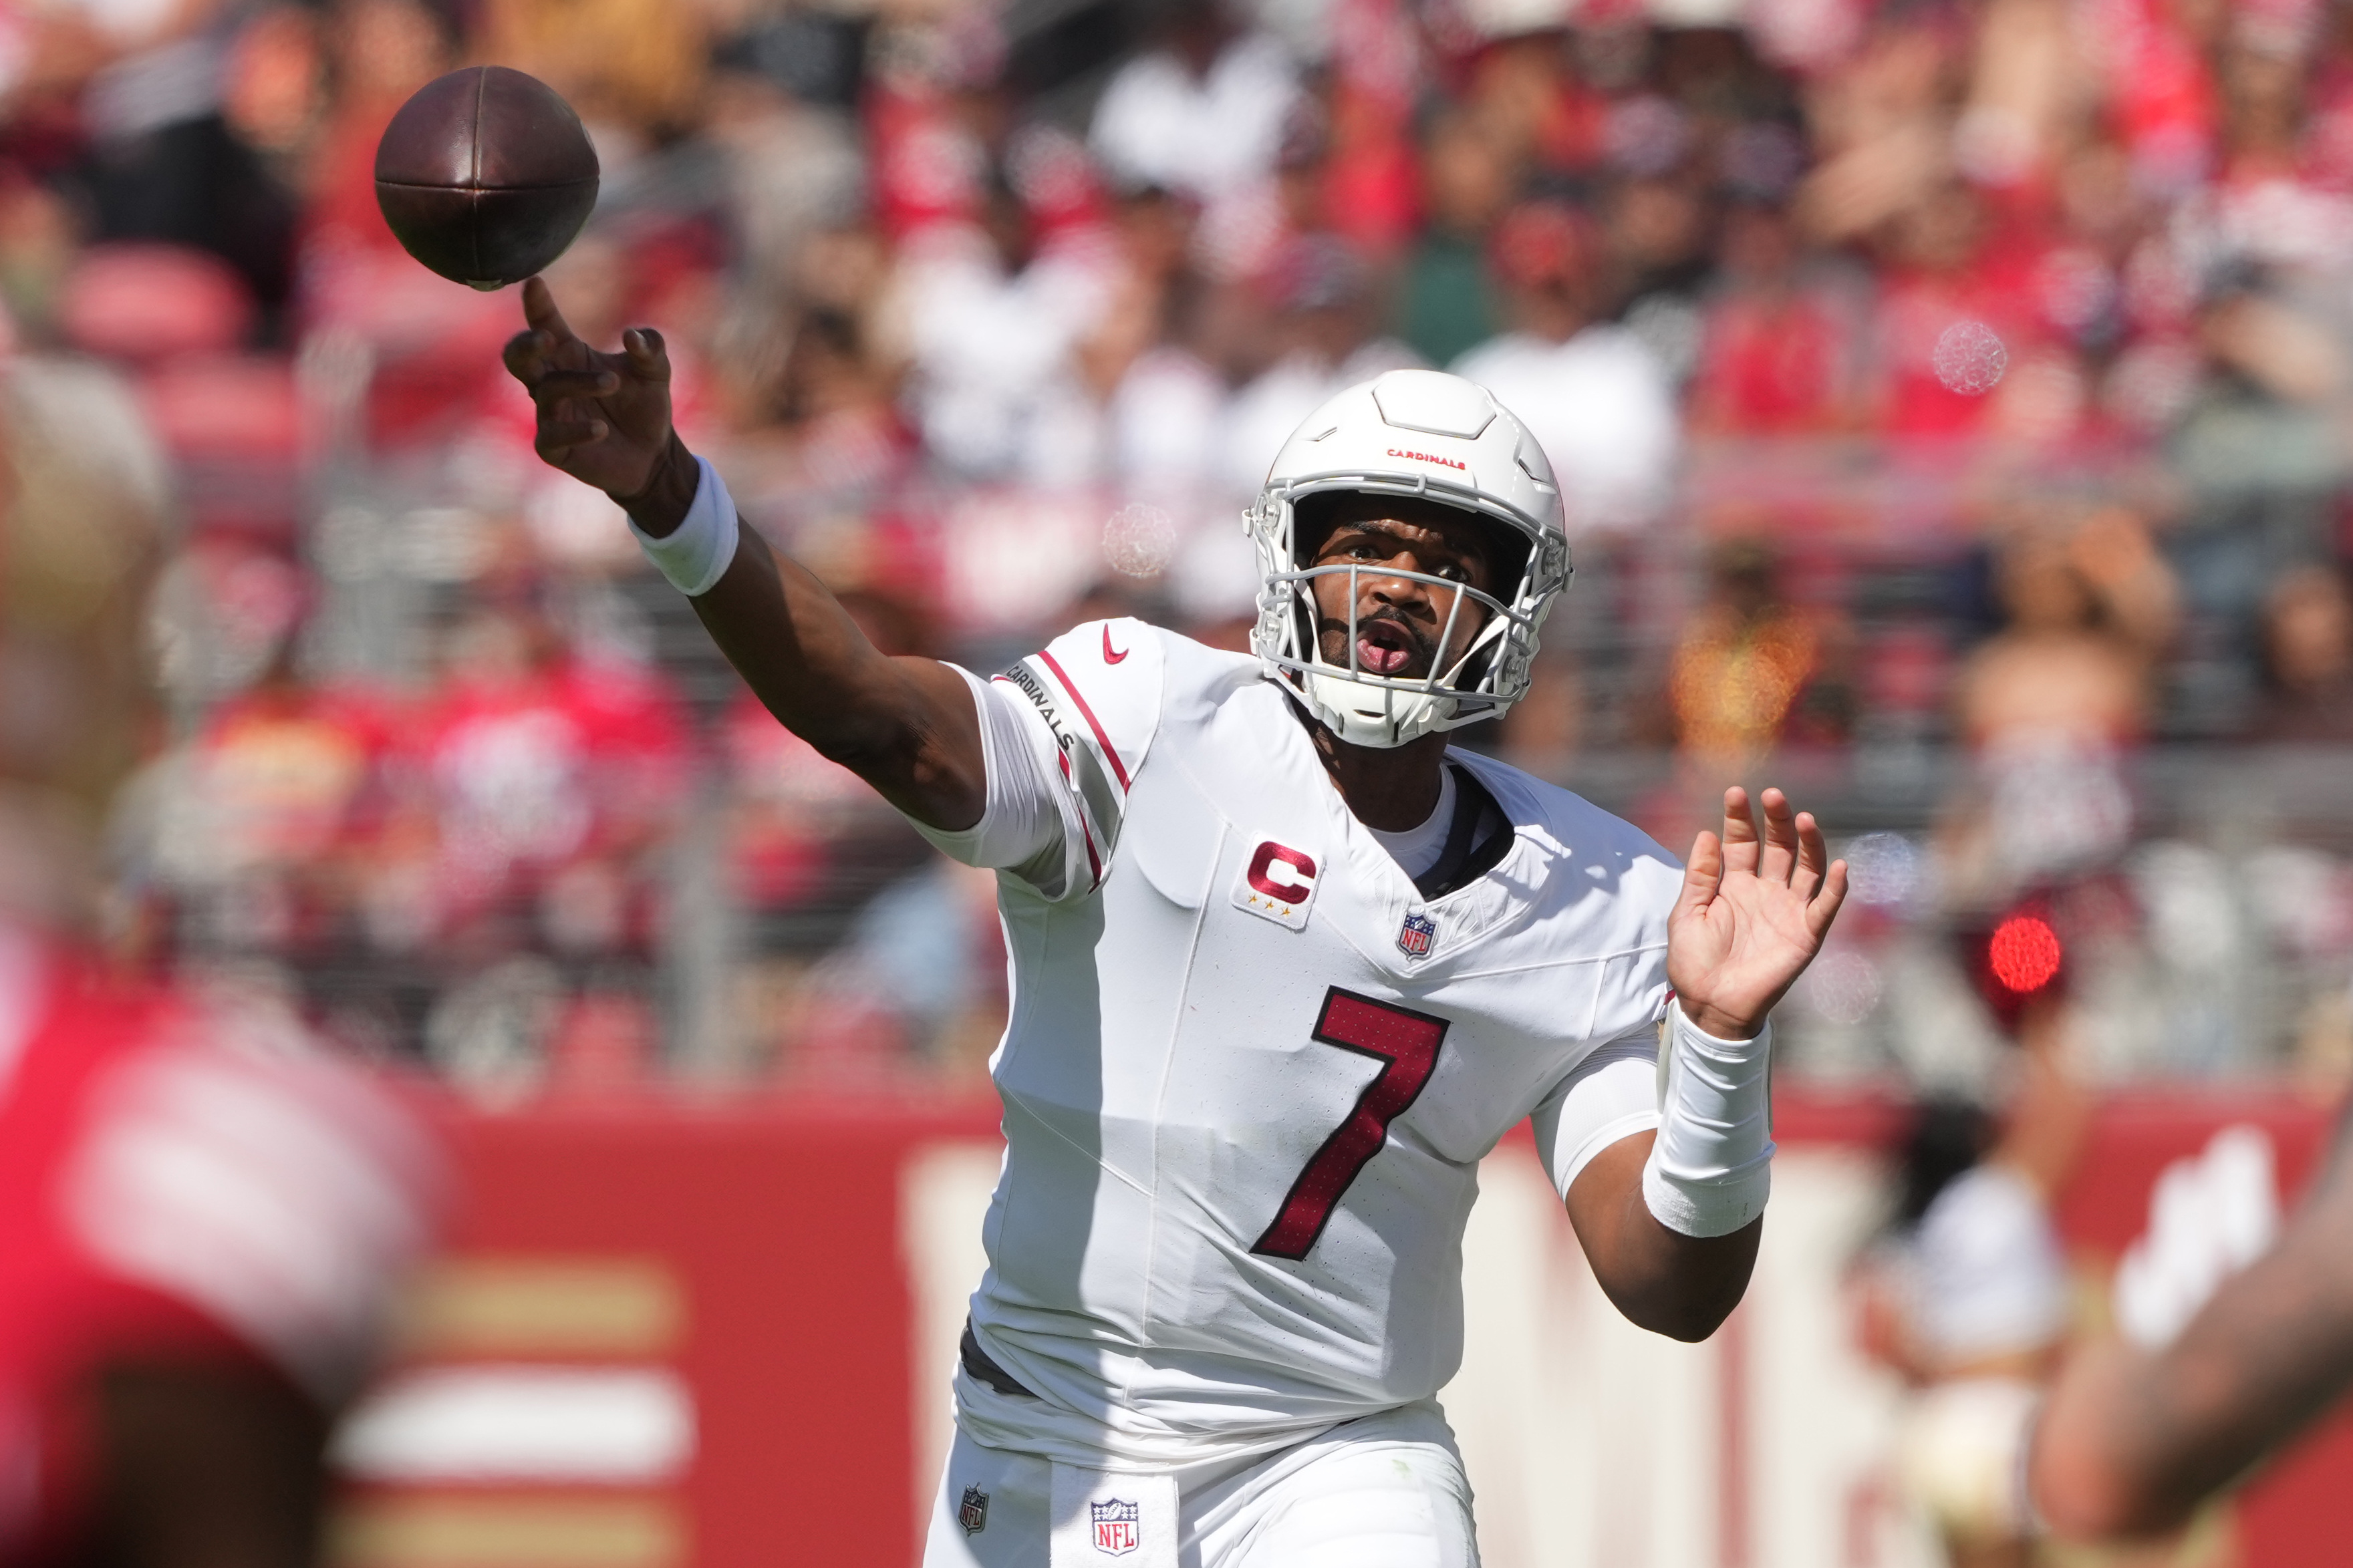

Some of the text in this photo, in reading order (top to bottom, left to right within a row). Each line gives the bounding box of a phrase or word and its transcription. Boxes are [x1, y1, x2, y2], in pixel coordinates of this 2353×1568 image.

[1387, 449, 1466, 470] CARDINALS
[1006, 665, 1075, 751] CARDINALS
[1247, 840, 1317, 905] C
[1401, 928, 1427, 951] NFL
[1248, 984, 1451, 1261] 7
[962, 1504, 980, 1527] NFL
[1097, 1523, 1134, 1550] NFL
